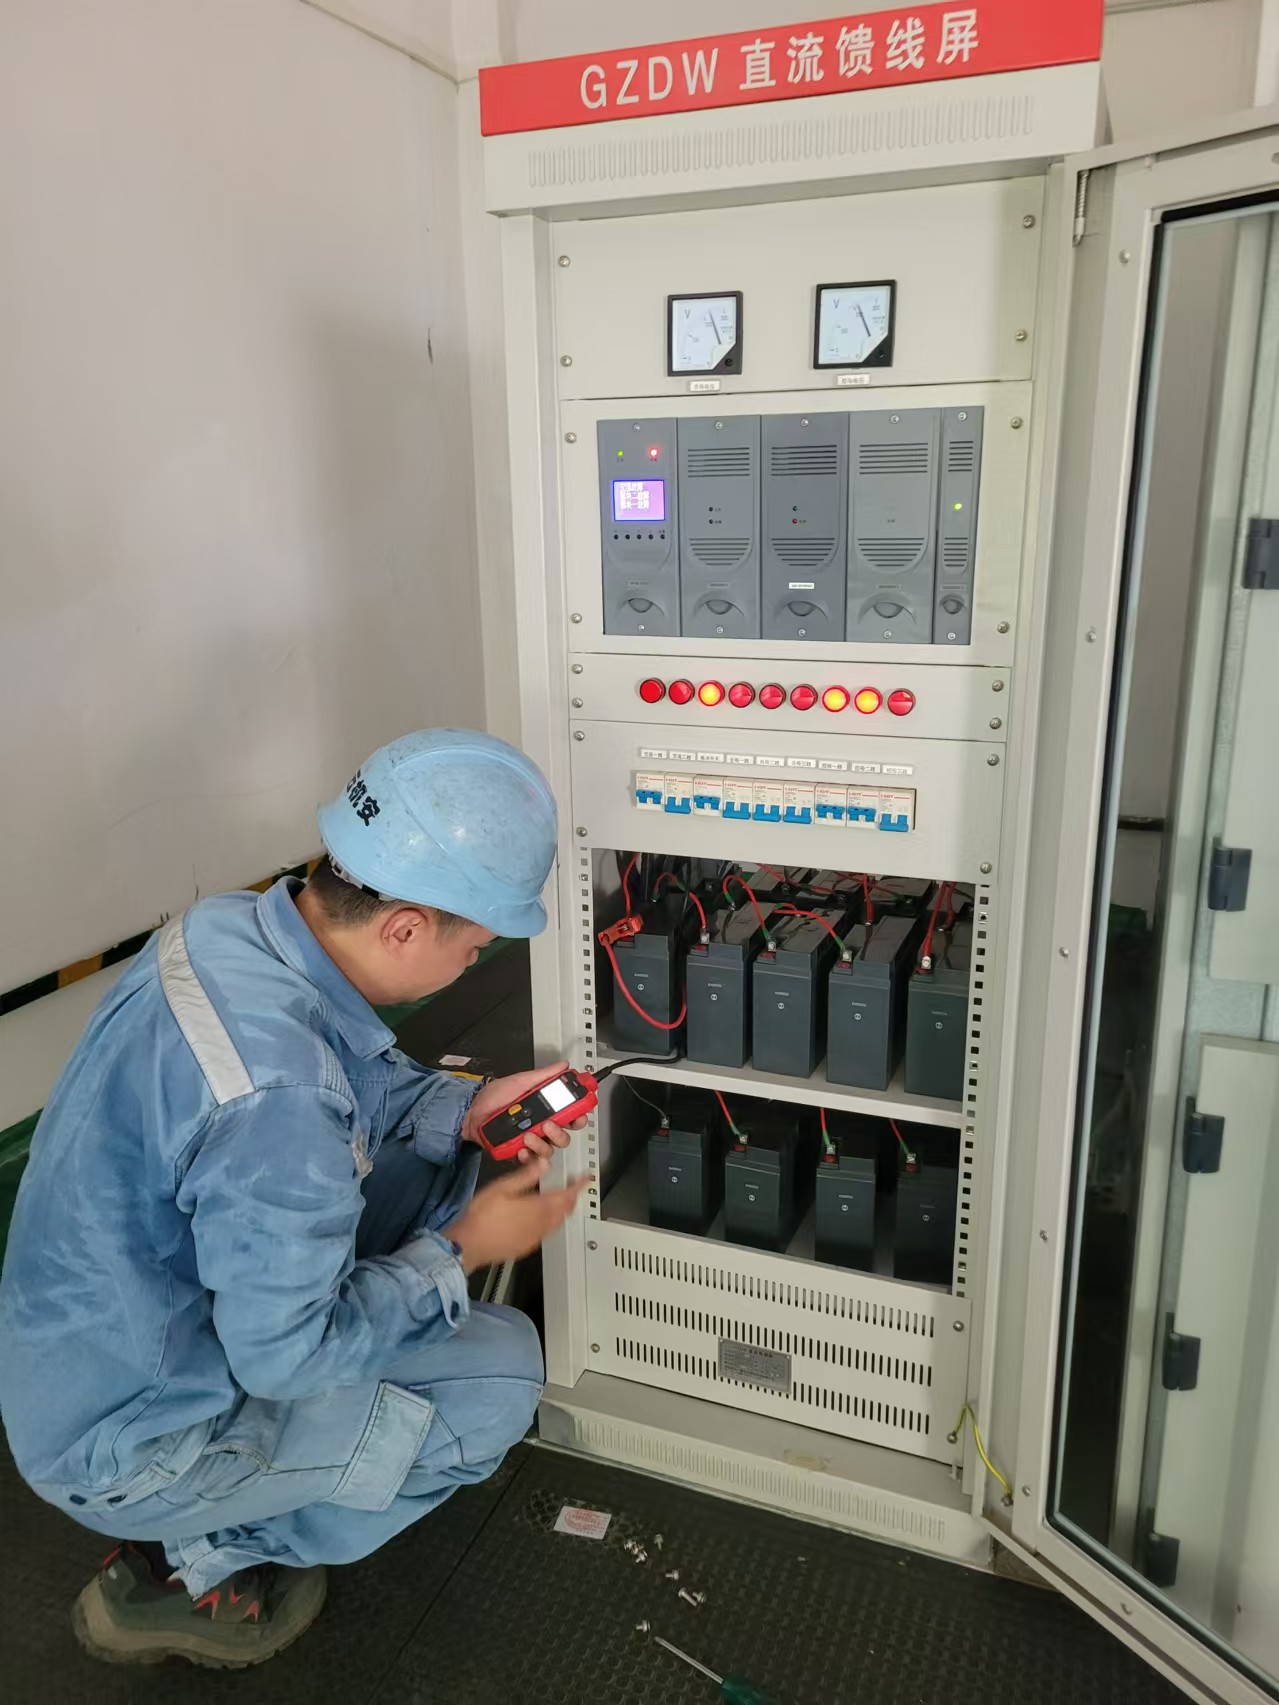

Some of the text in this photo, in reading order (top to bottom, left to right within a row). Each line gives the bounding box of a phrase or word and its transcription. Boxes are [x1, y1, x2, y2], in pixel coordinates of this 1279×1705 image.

[580, 8, 980, 110] GZDW 直流馈线屏
